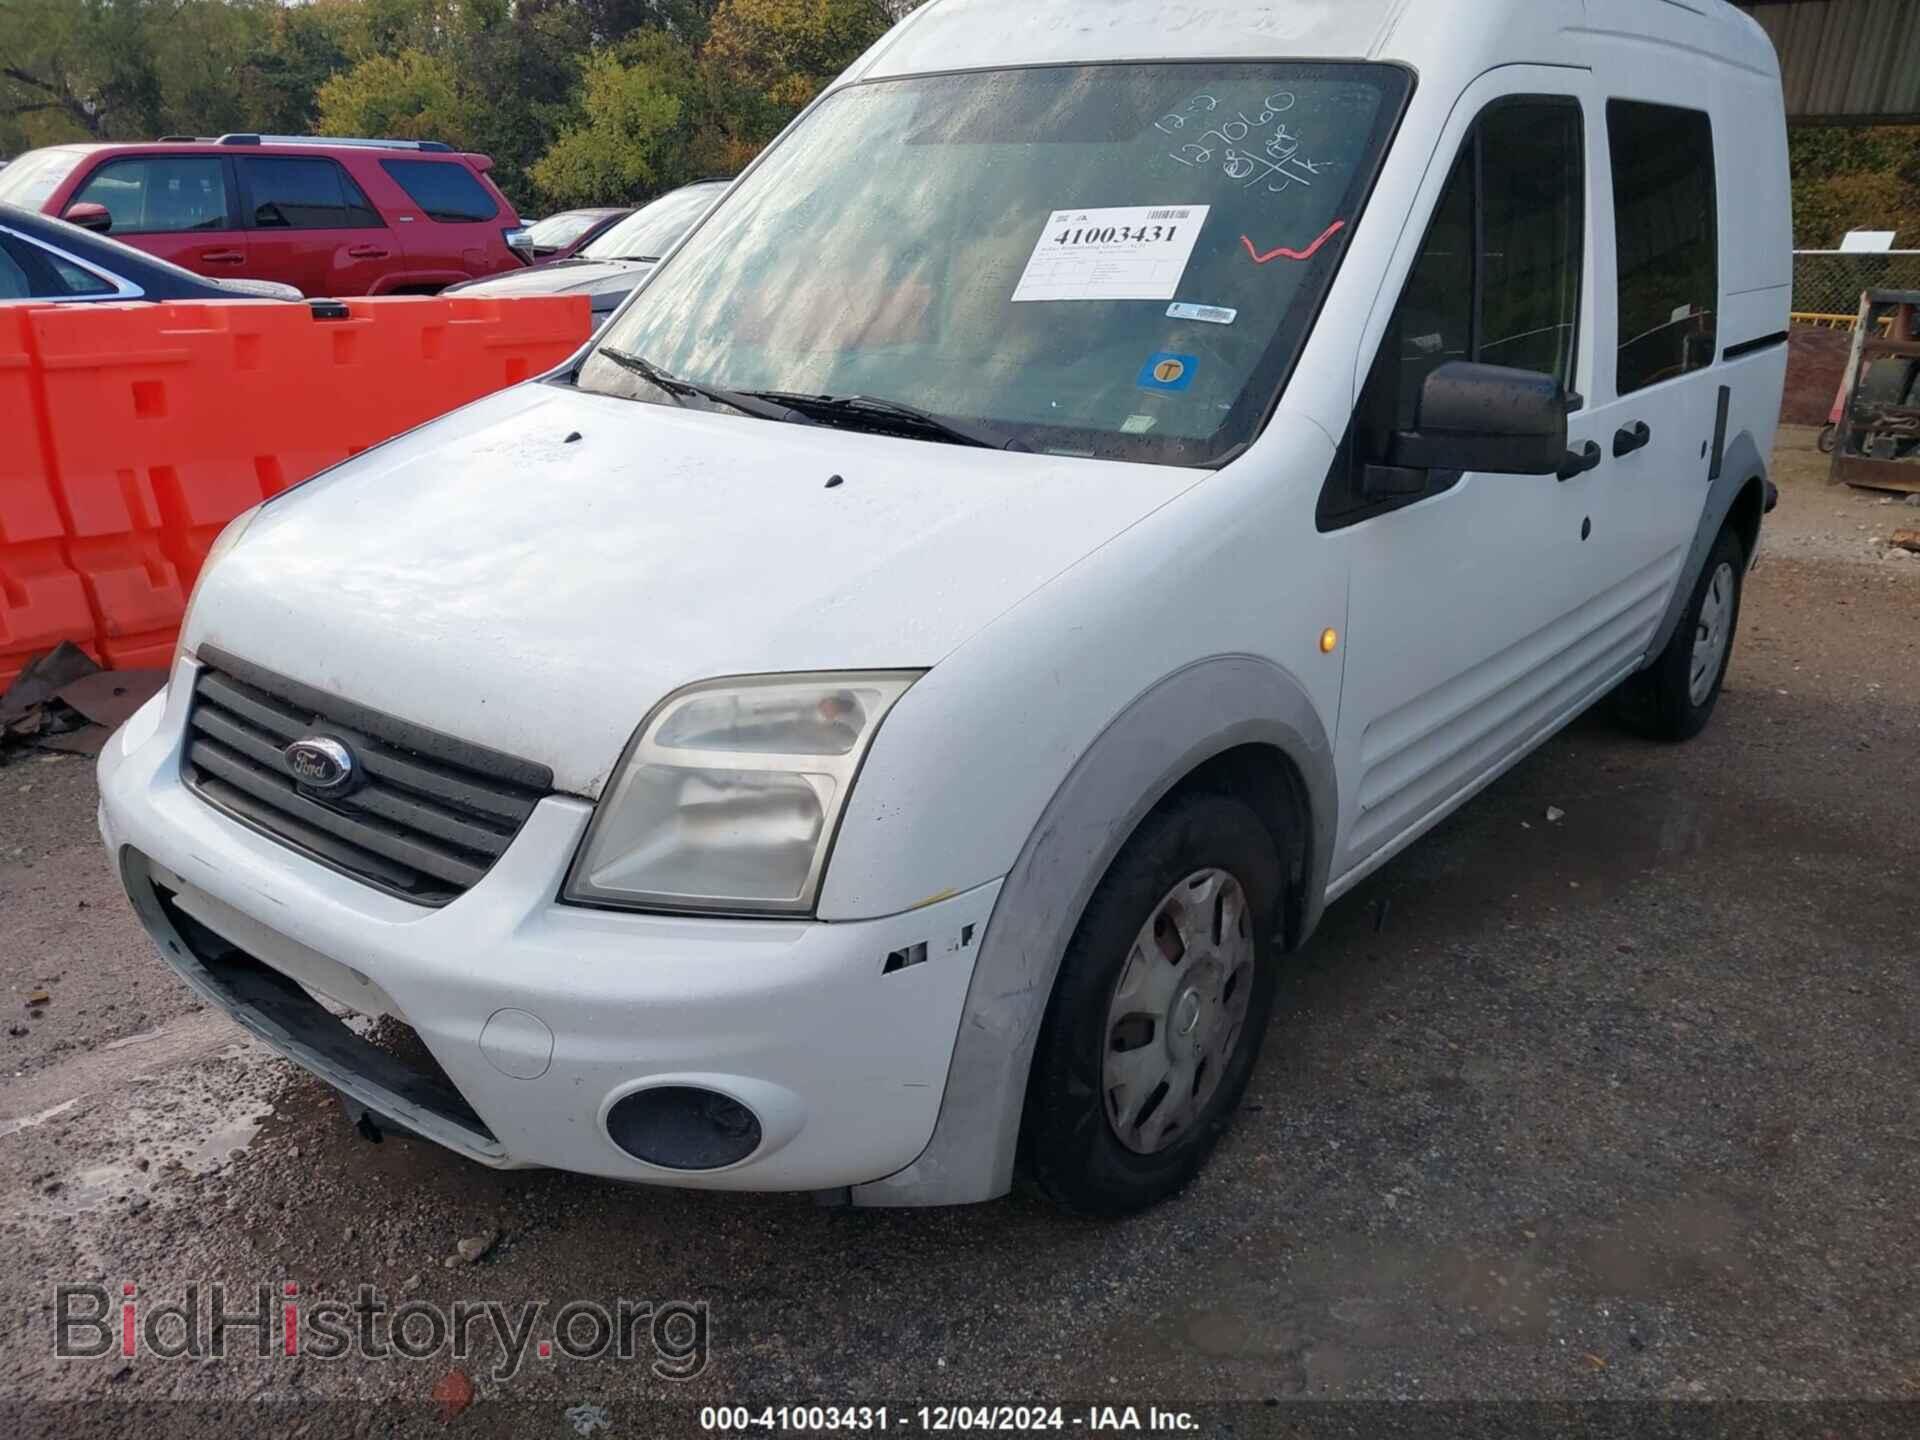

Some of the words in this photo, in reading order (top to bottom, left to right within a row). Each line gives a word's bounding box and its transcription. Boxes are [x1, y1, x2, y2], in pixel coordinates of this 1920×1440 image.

[1054, 225, 1178, 245] 41003431
[1163, 363, 1181, 380] T
[294, 750, 326, 778] Ford
